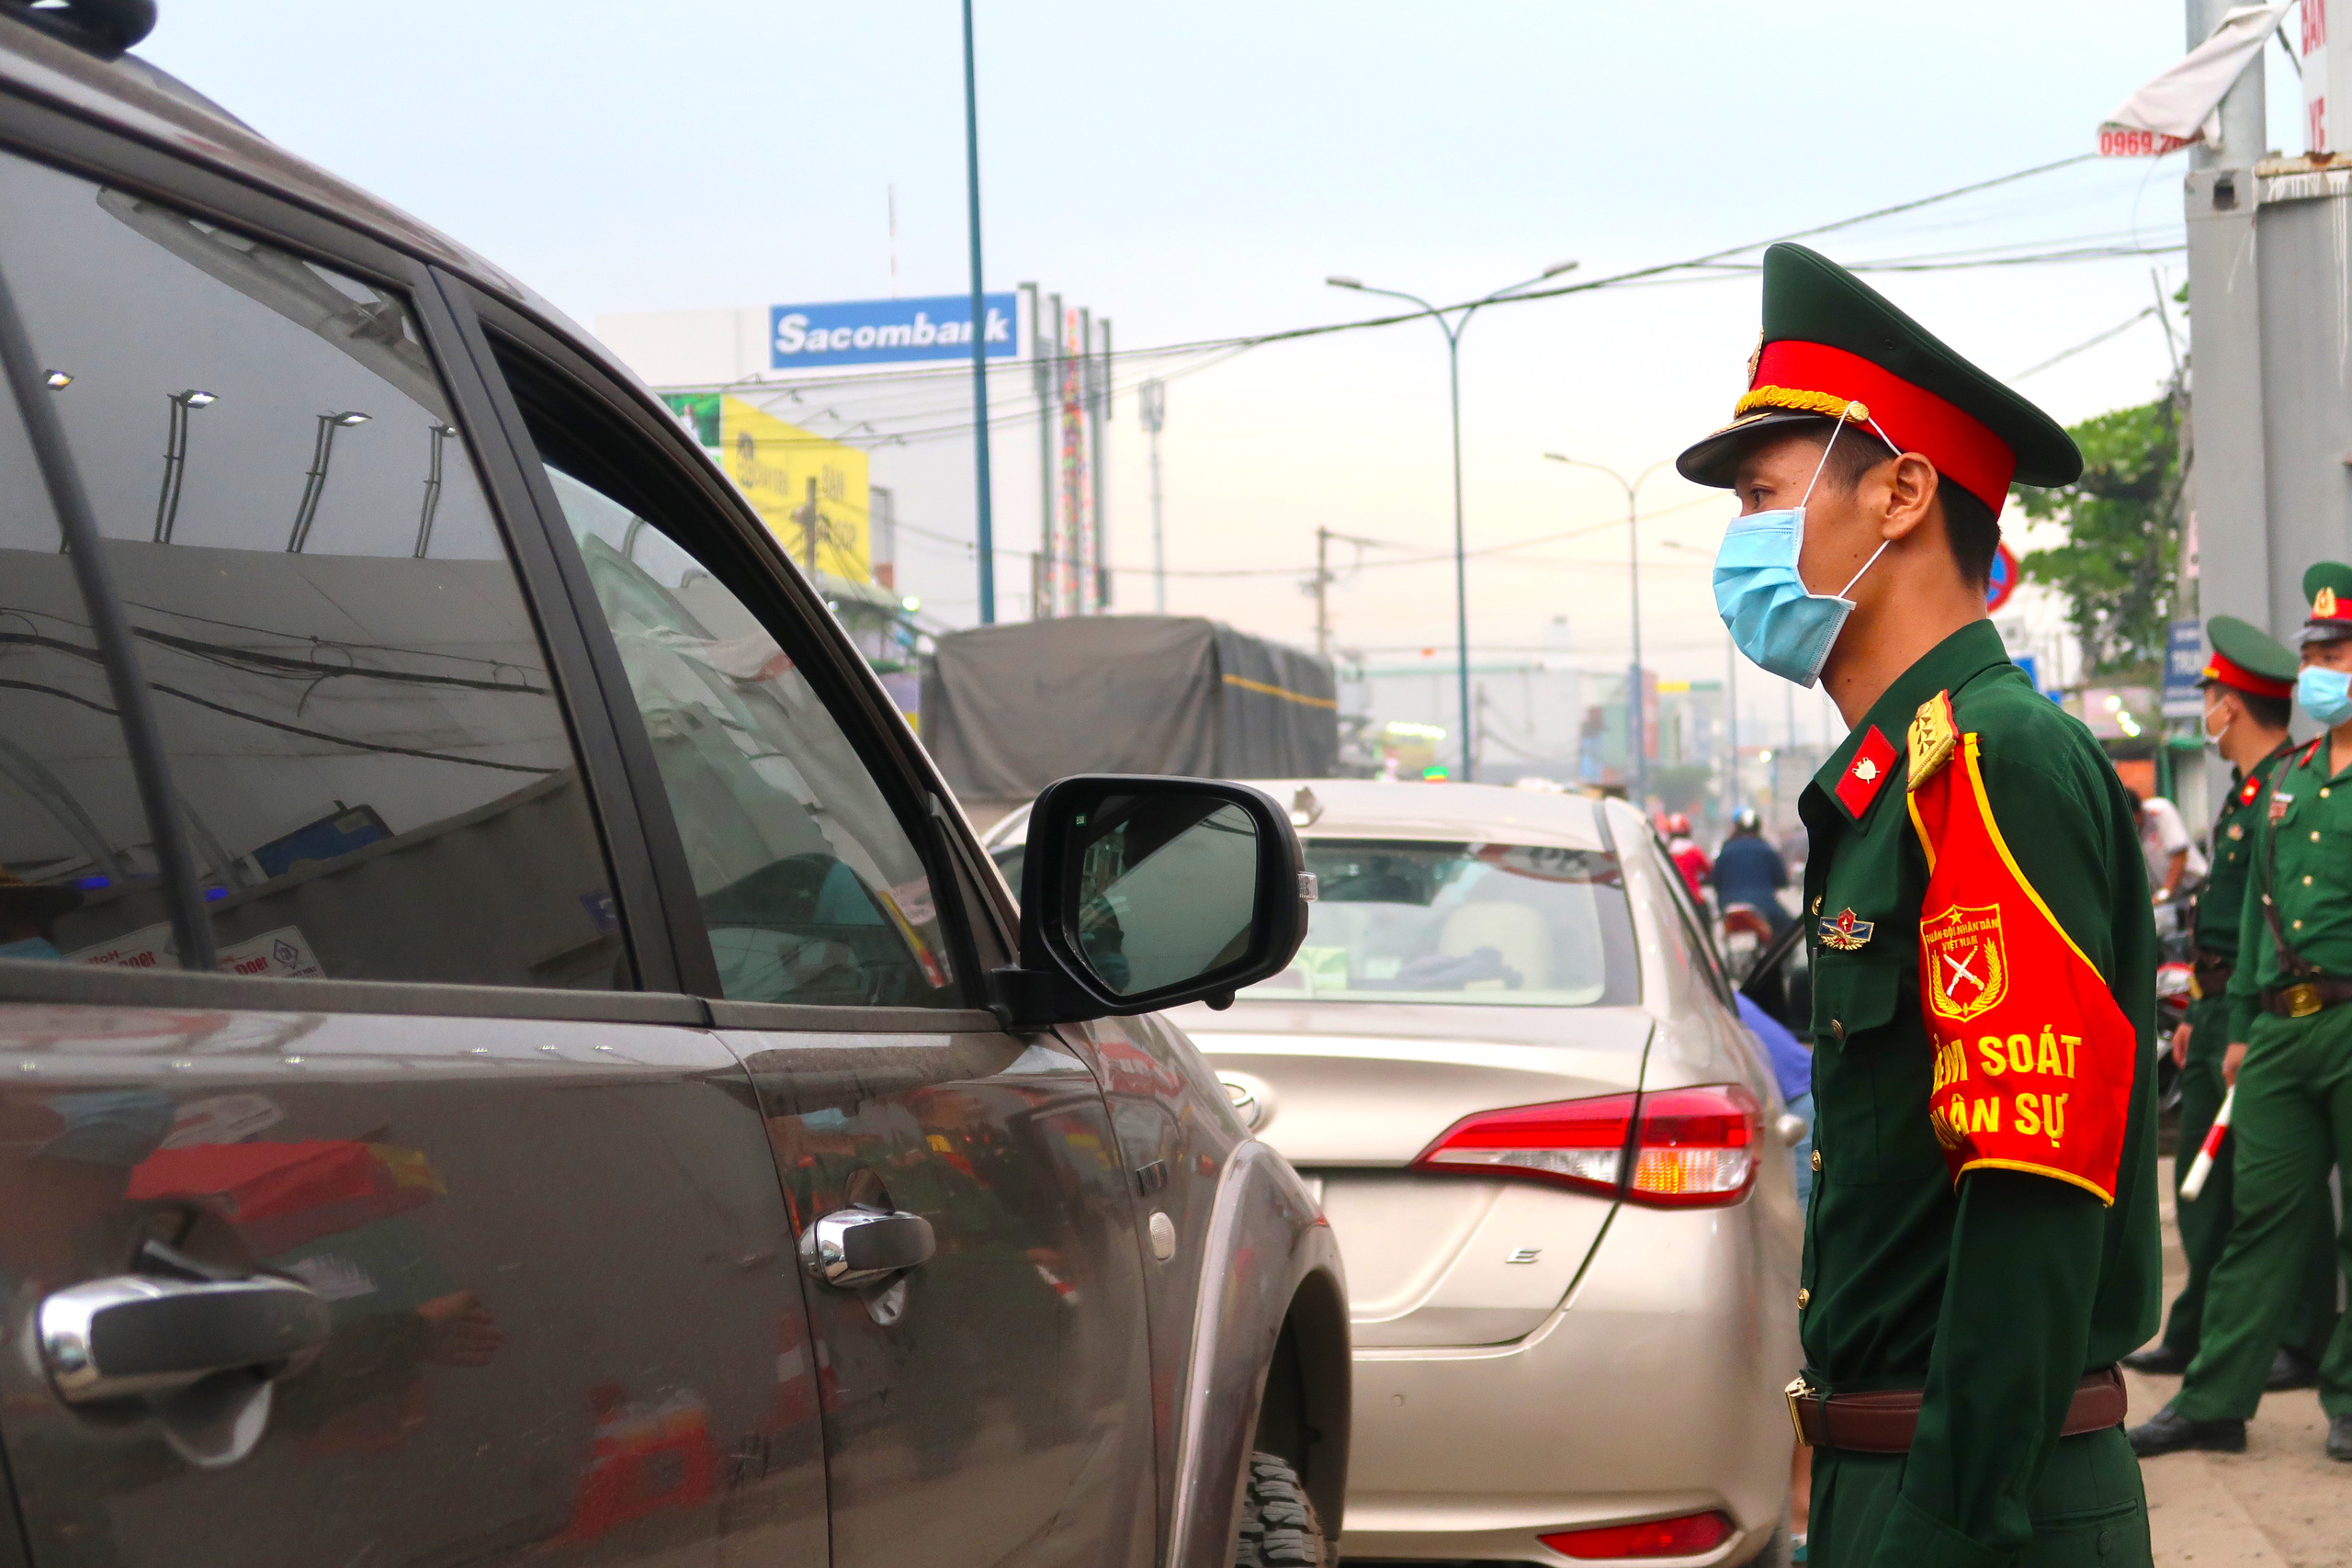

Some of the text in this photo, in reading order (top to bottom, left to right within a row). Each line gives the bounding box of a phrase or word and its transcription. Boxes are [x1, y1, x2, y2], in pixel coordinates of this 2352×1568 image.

[1957, 921, 1979, 935] NHÂN
[1979, 918, 1999, 931] DÂN
[1959, 935, 1978, 947] NAM
[1930, 1024, 2082, 1099] ỂM SOÁT
[1930, 1092, 2069, 1150] UÂN SỰ
[1506, 1247, 1543, 1264] E
